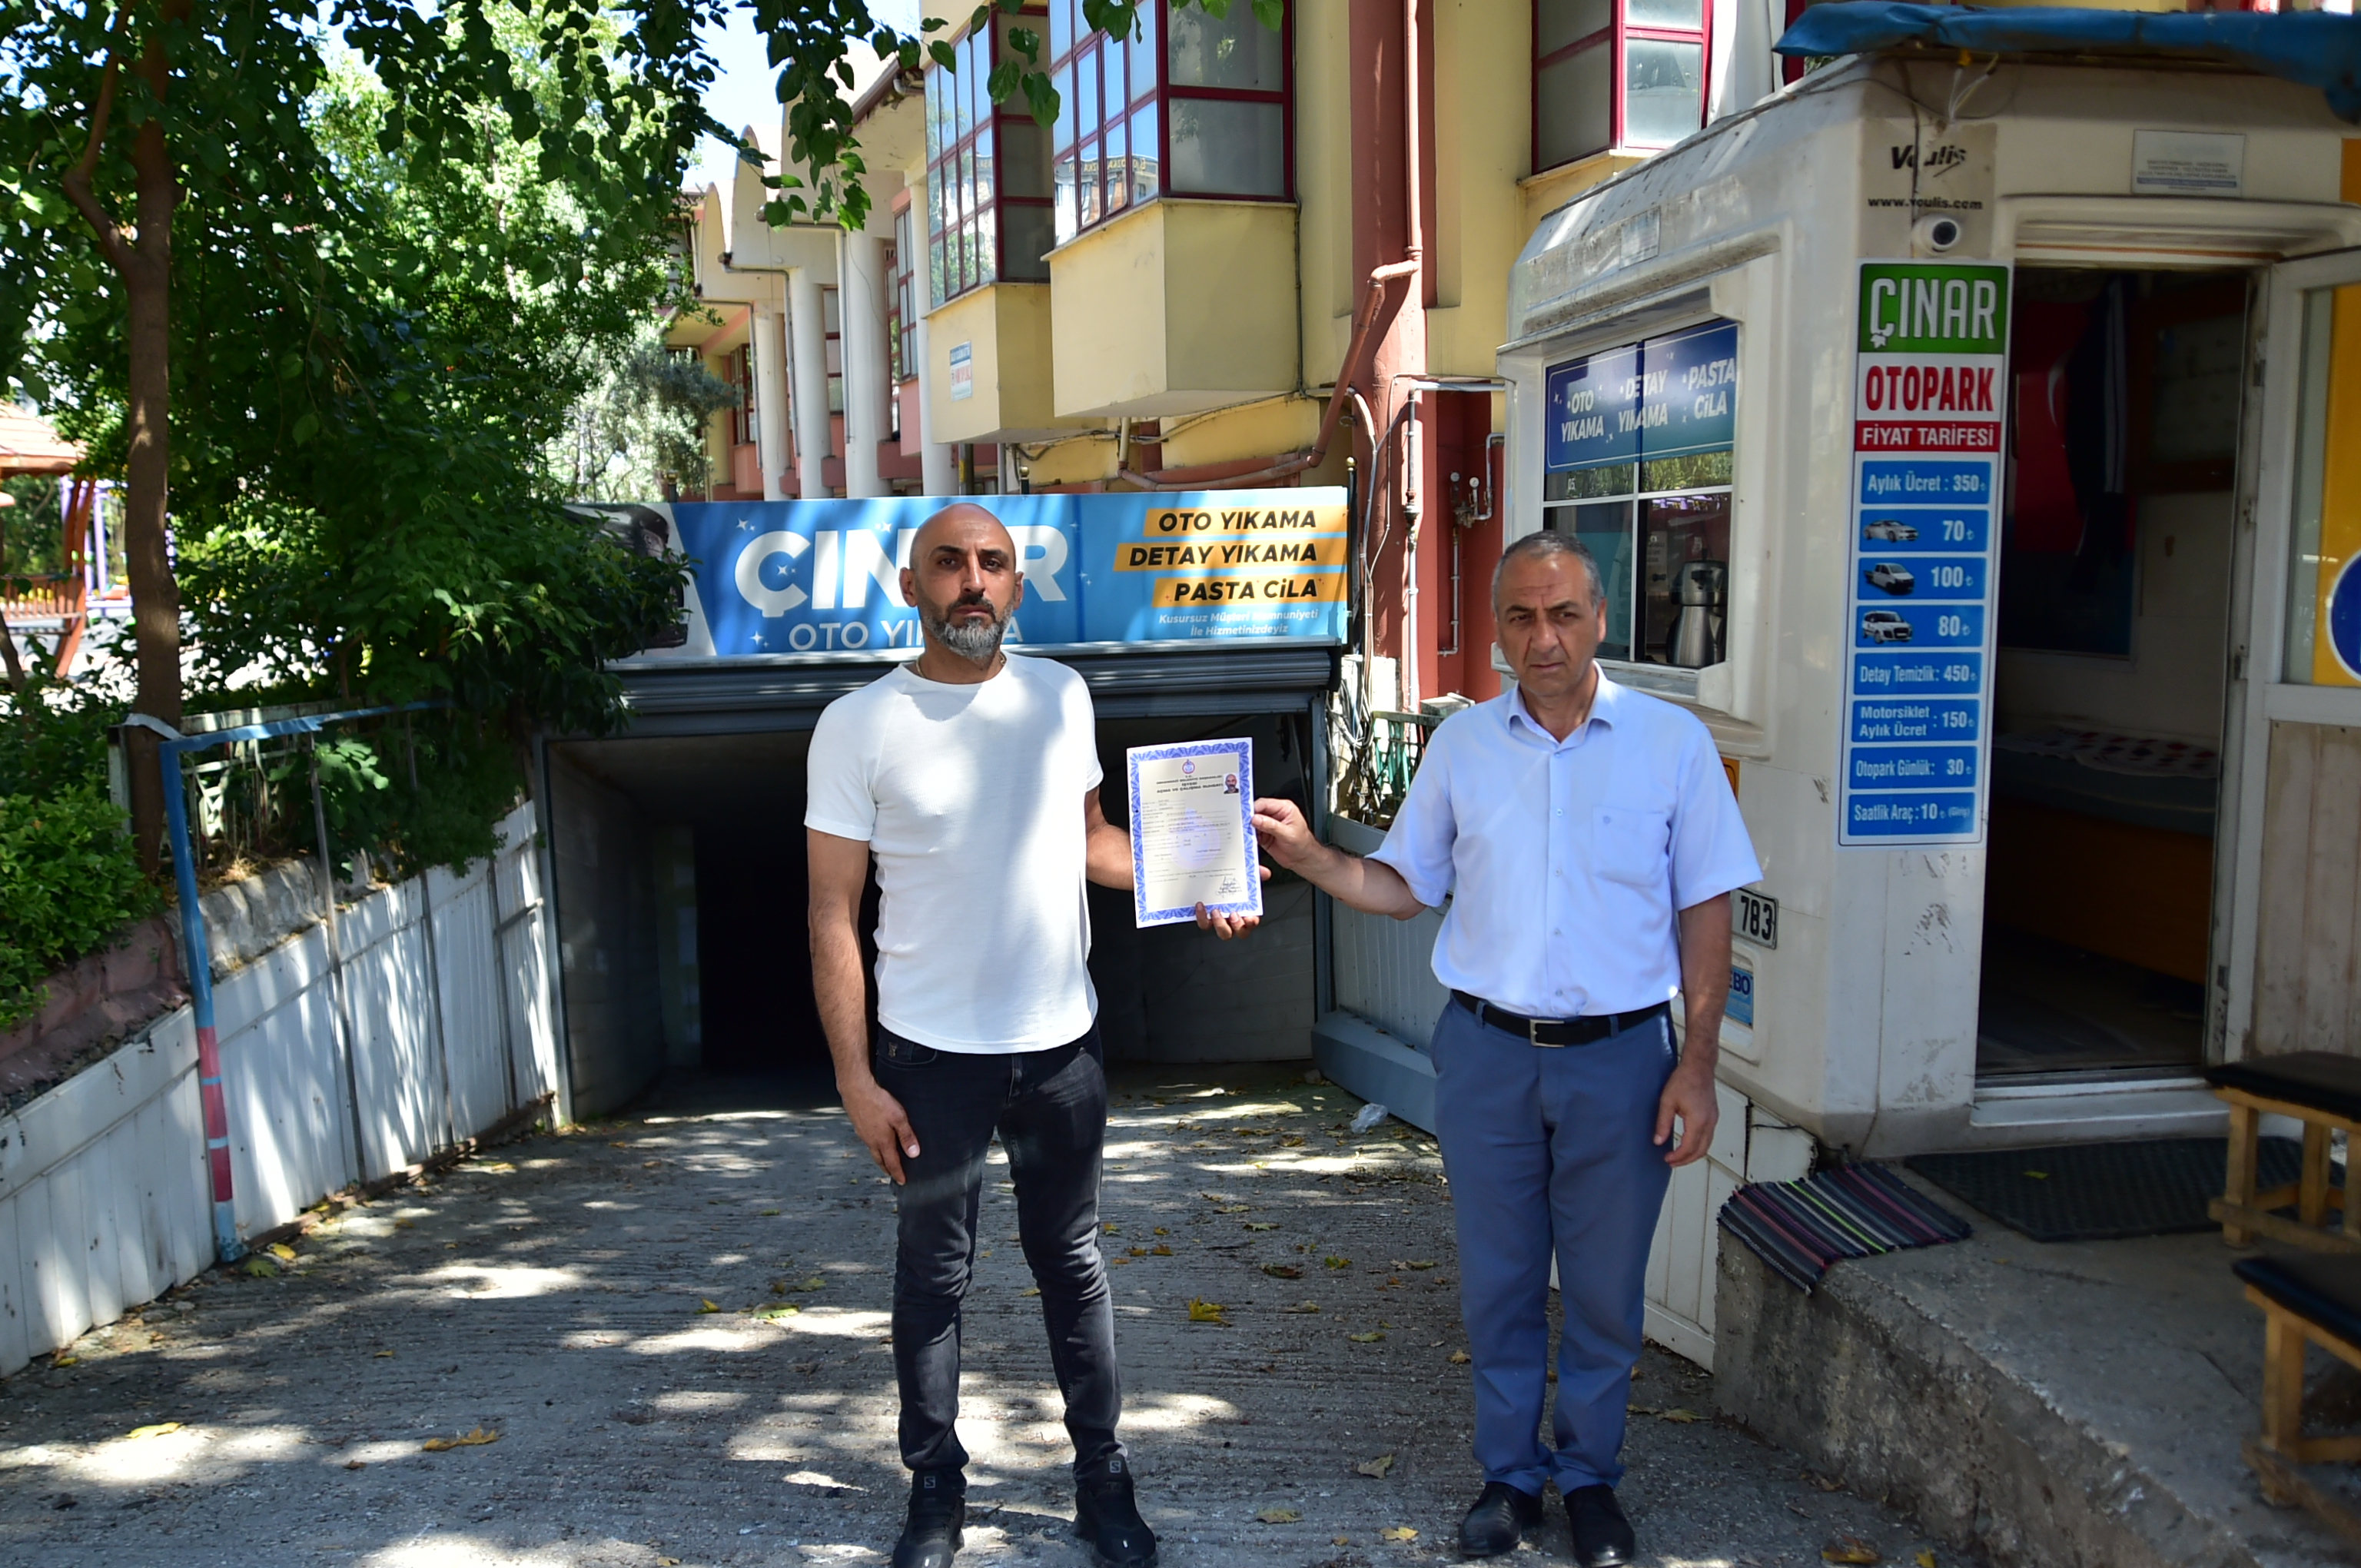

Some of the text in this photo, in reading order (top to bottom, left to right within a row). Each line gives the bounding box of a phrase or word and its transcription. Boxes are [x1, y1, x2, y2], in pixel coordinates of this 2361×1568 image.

[1868, 197, 1983, 210] www.voulis.com
[1870, 277, 1996, 348] ÇINAR
[1625, 358, 1735, 400] DETAY PASTA
[1865, 365, 1994, 412] OTOPARK
[1571, 390, 1593, 414] OTO
[1618, 403, 1668, 433] YIKAMA
[1561, 415, 1604, 443] YIKAMA
[1862, 424, 1994, 446] FİYAT TARİFESİ
[1868, 474, 1901, 494] Aylık
[1905, 470, 1941, 491] Ücret
[1159, 510, 1317, 532] OTO YIKAMA
[1129, 543, 1317, 566] DETAY YIKAMA
[735, 525, 1068, 618] ÇINR
[1174, 581, 1254, 601] PASTA
[1159, 614, 1208, 623] Kusursuz
[1210, 611, 1250, 623] Müşteri
[789, 620, 868, 650] OTO
[1190, 624, 1288, 636] İle Hizmetinizdeyiz
[1860, 666, 1891, 686] Detay
[1861, 706, 1929, 719] Motorsiklet
[1859, 721, 1927, 739] Aylık Ücret
[1856, 760, 1895, 779] Otopark
[1855, 804, 1889, 821] Saatlik
[1741, 895, 1773, 941] 783
